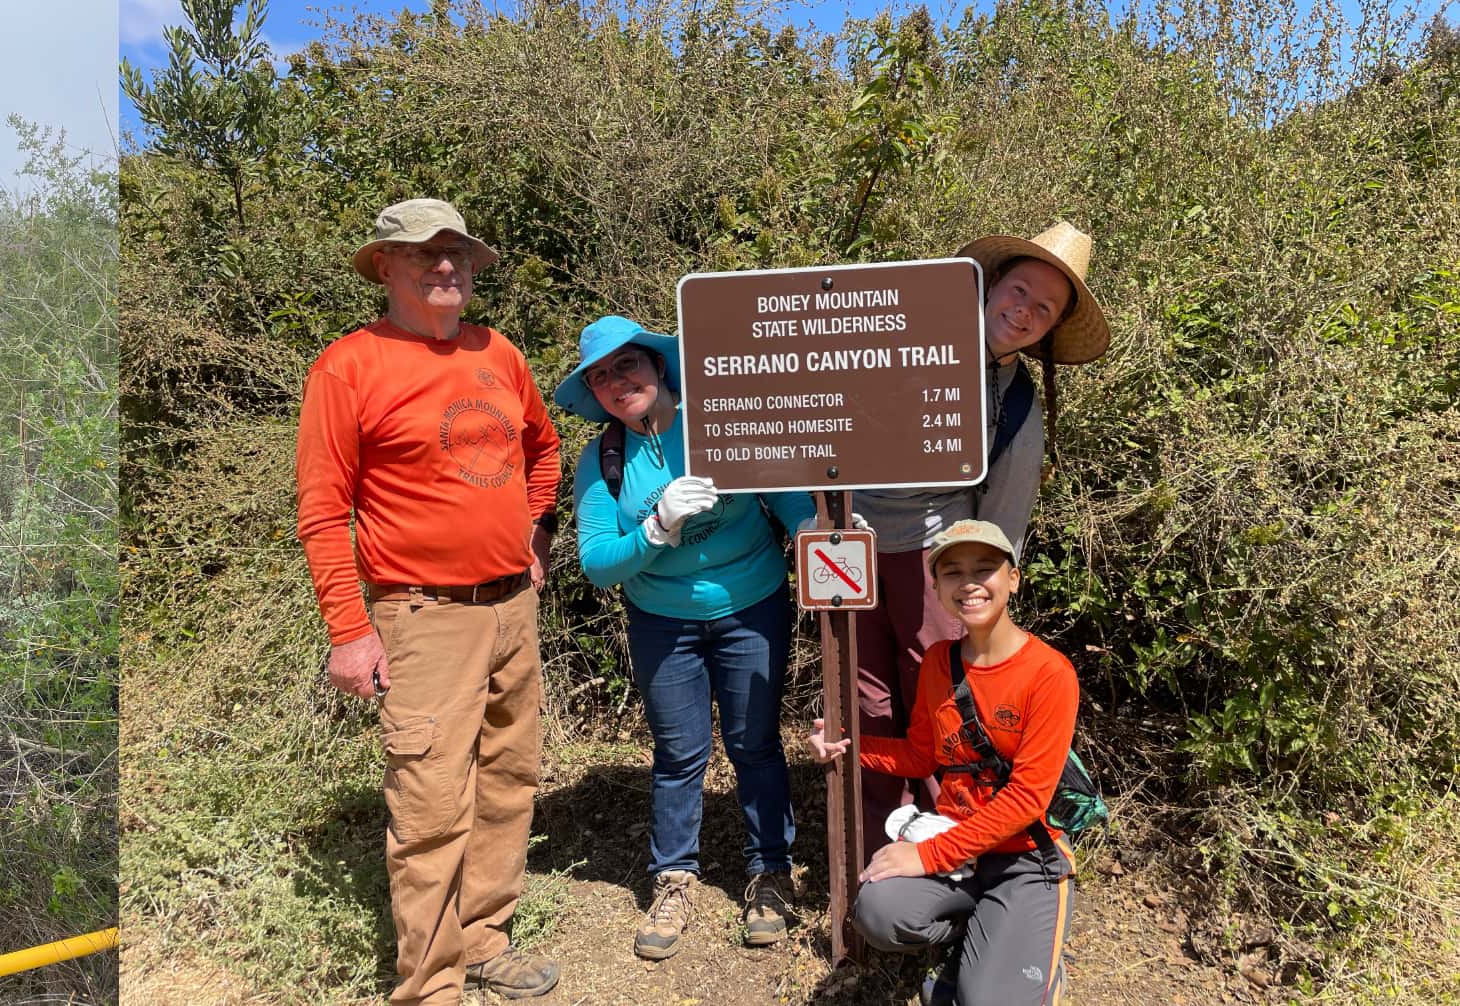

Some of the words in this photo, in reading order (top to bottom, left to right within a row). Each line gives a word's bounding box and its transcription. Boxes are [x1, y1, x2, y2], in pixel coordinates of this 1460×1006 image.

[757, 295, 810, 313] BONEY
[815, 289, 899, 310] MOUNTAIN
[752, 320, 797, 338] STATE
[802, 314, 906, 335] WILDERNESS
[704, 353, 799, 376] SERRANO
[807, 348, 891, 371] CANYON
[898, 345, 960, 366] TRAIL
[704, 397, 762, 412] SERRANO
[766, 393, 844, 409] CONNECTOR
[922, 389, 940, 402] 1.7
[945, 388, 960, 401] MI
[443, 399, 473, 421] MONICA
[475, 400, 518, 442] MOUNTAINS
[704, 424, 720, 437] TO
[725, 421, 783, 436] SERRANO
[789, 418, 852, 433] HOMESITE
[922, 414, 942, 428] 2.4
[946, 413, 960, 426] MI
[706, 449, 721, 462] TO
[726, 448, 750, 461] OLD
[755, 446, 796, 460] BONEY
[800, 445, 836, 458] TRAIL
[923, 439, 942, 453] 3.4
[946, 438, 961, 452] MI
